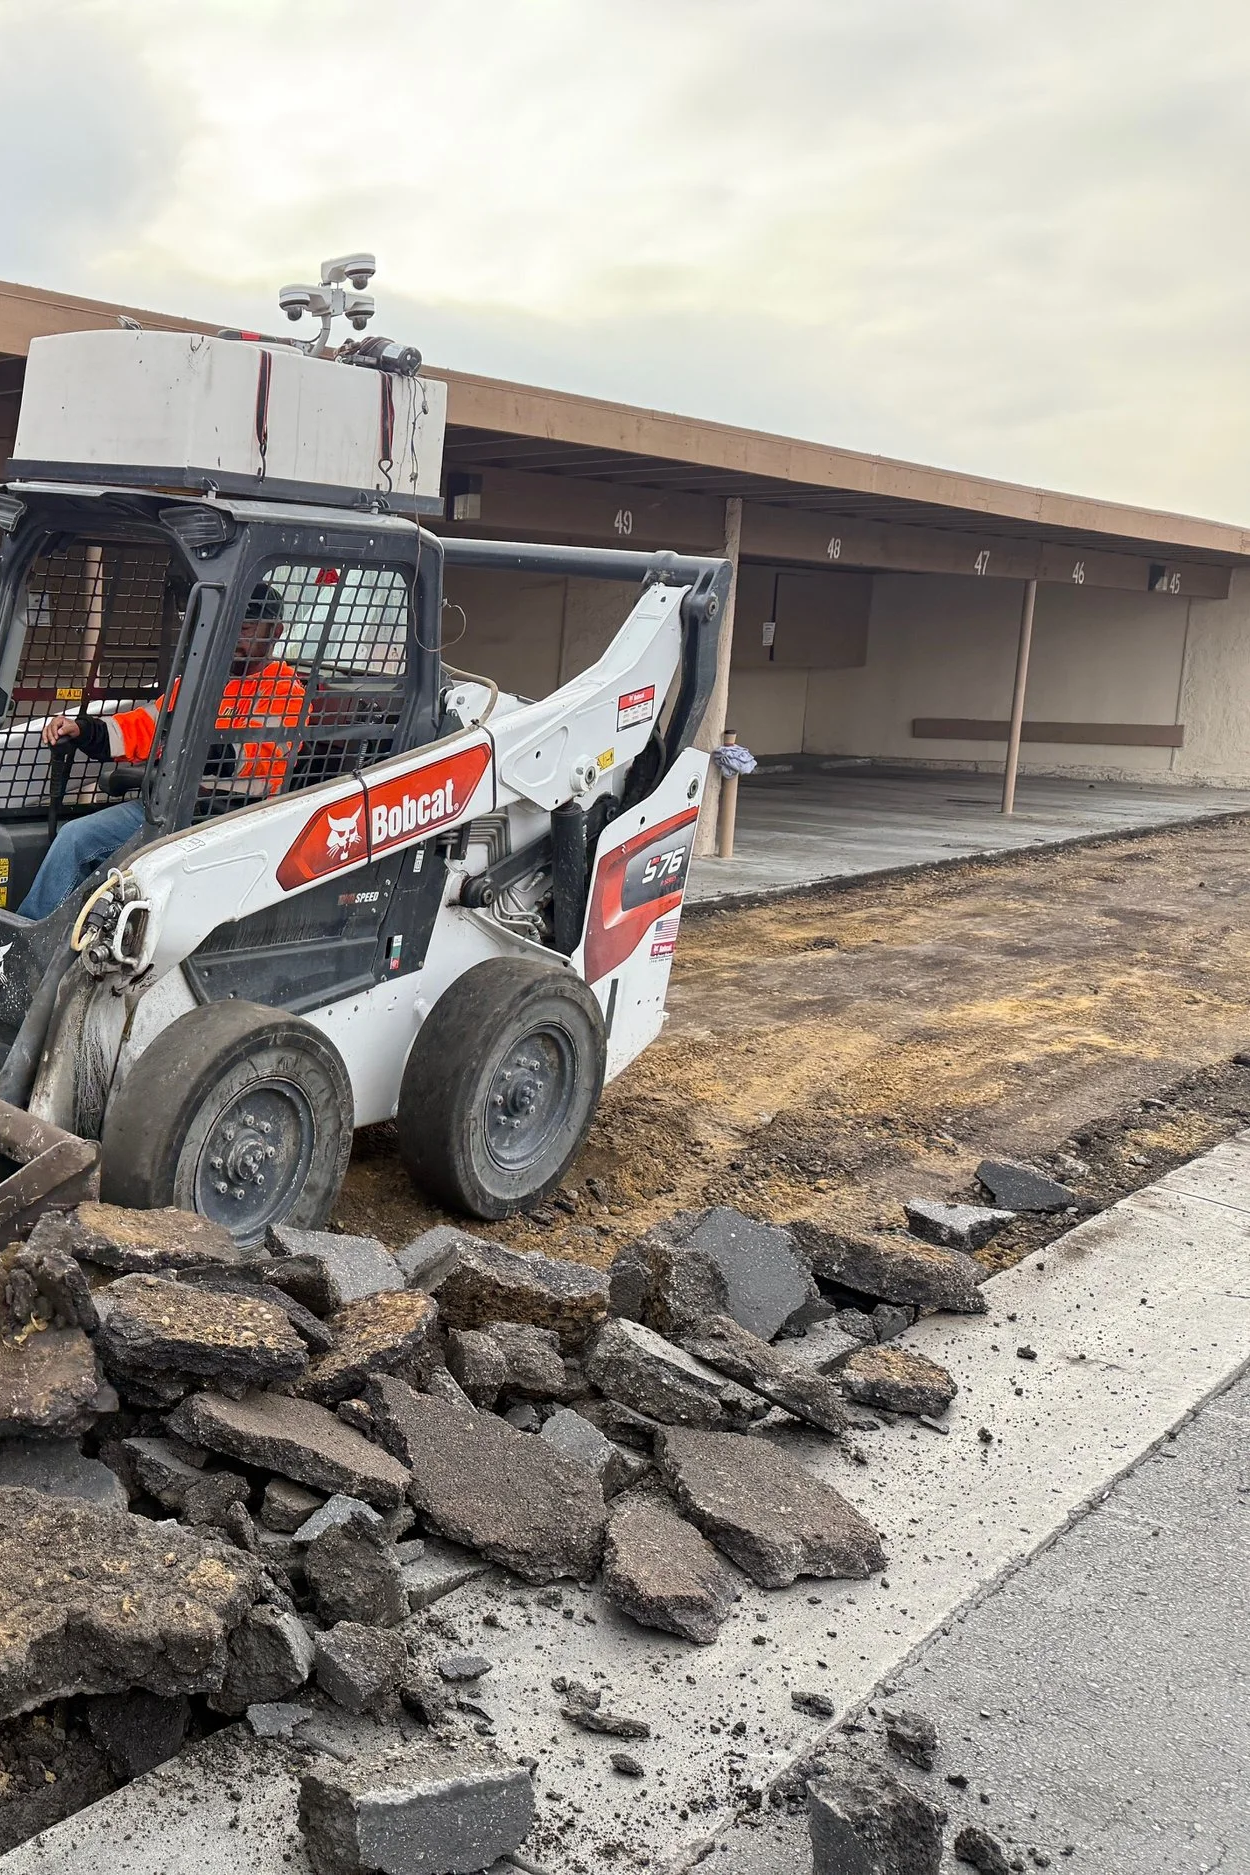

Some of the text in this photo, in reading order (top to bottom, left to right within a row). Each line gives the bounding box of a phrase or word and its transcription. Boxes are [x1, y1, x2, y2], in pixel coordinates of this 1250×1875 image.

[613, 509, 633, 535] 49
[827, 537, 842, 560] 48
[974, 550, 990, 576] 47
[1072, 561, 1085, 585] 46
[1169, 573, 1181, 594] 45
[371, 778, 454, 845] Bobcat
[641, 846, 686, 884] S76
